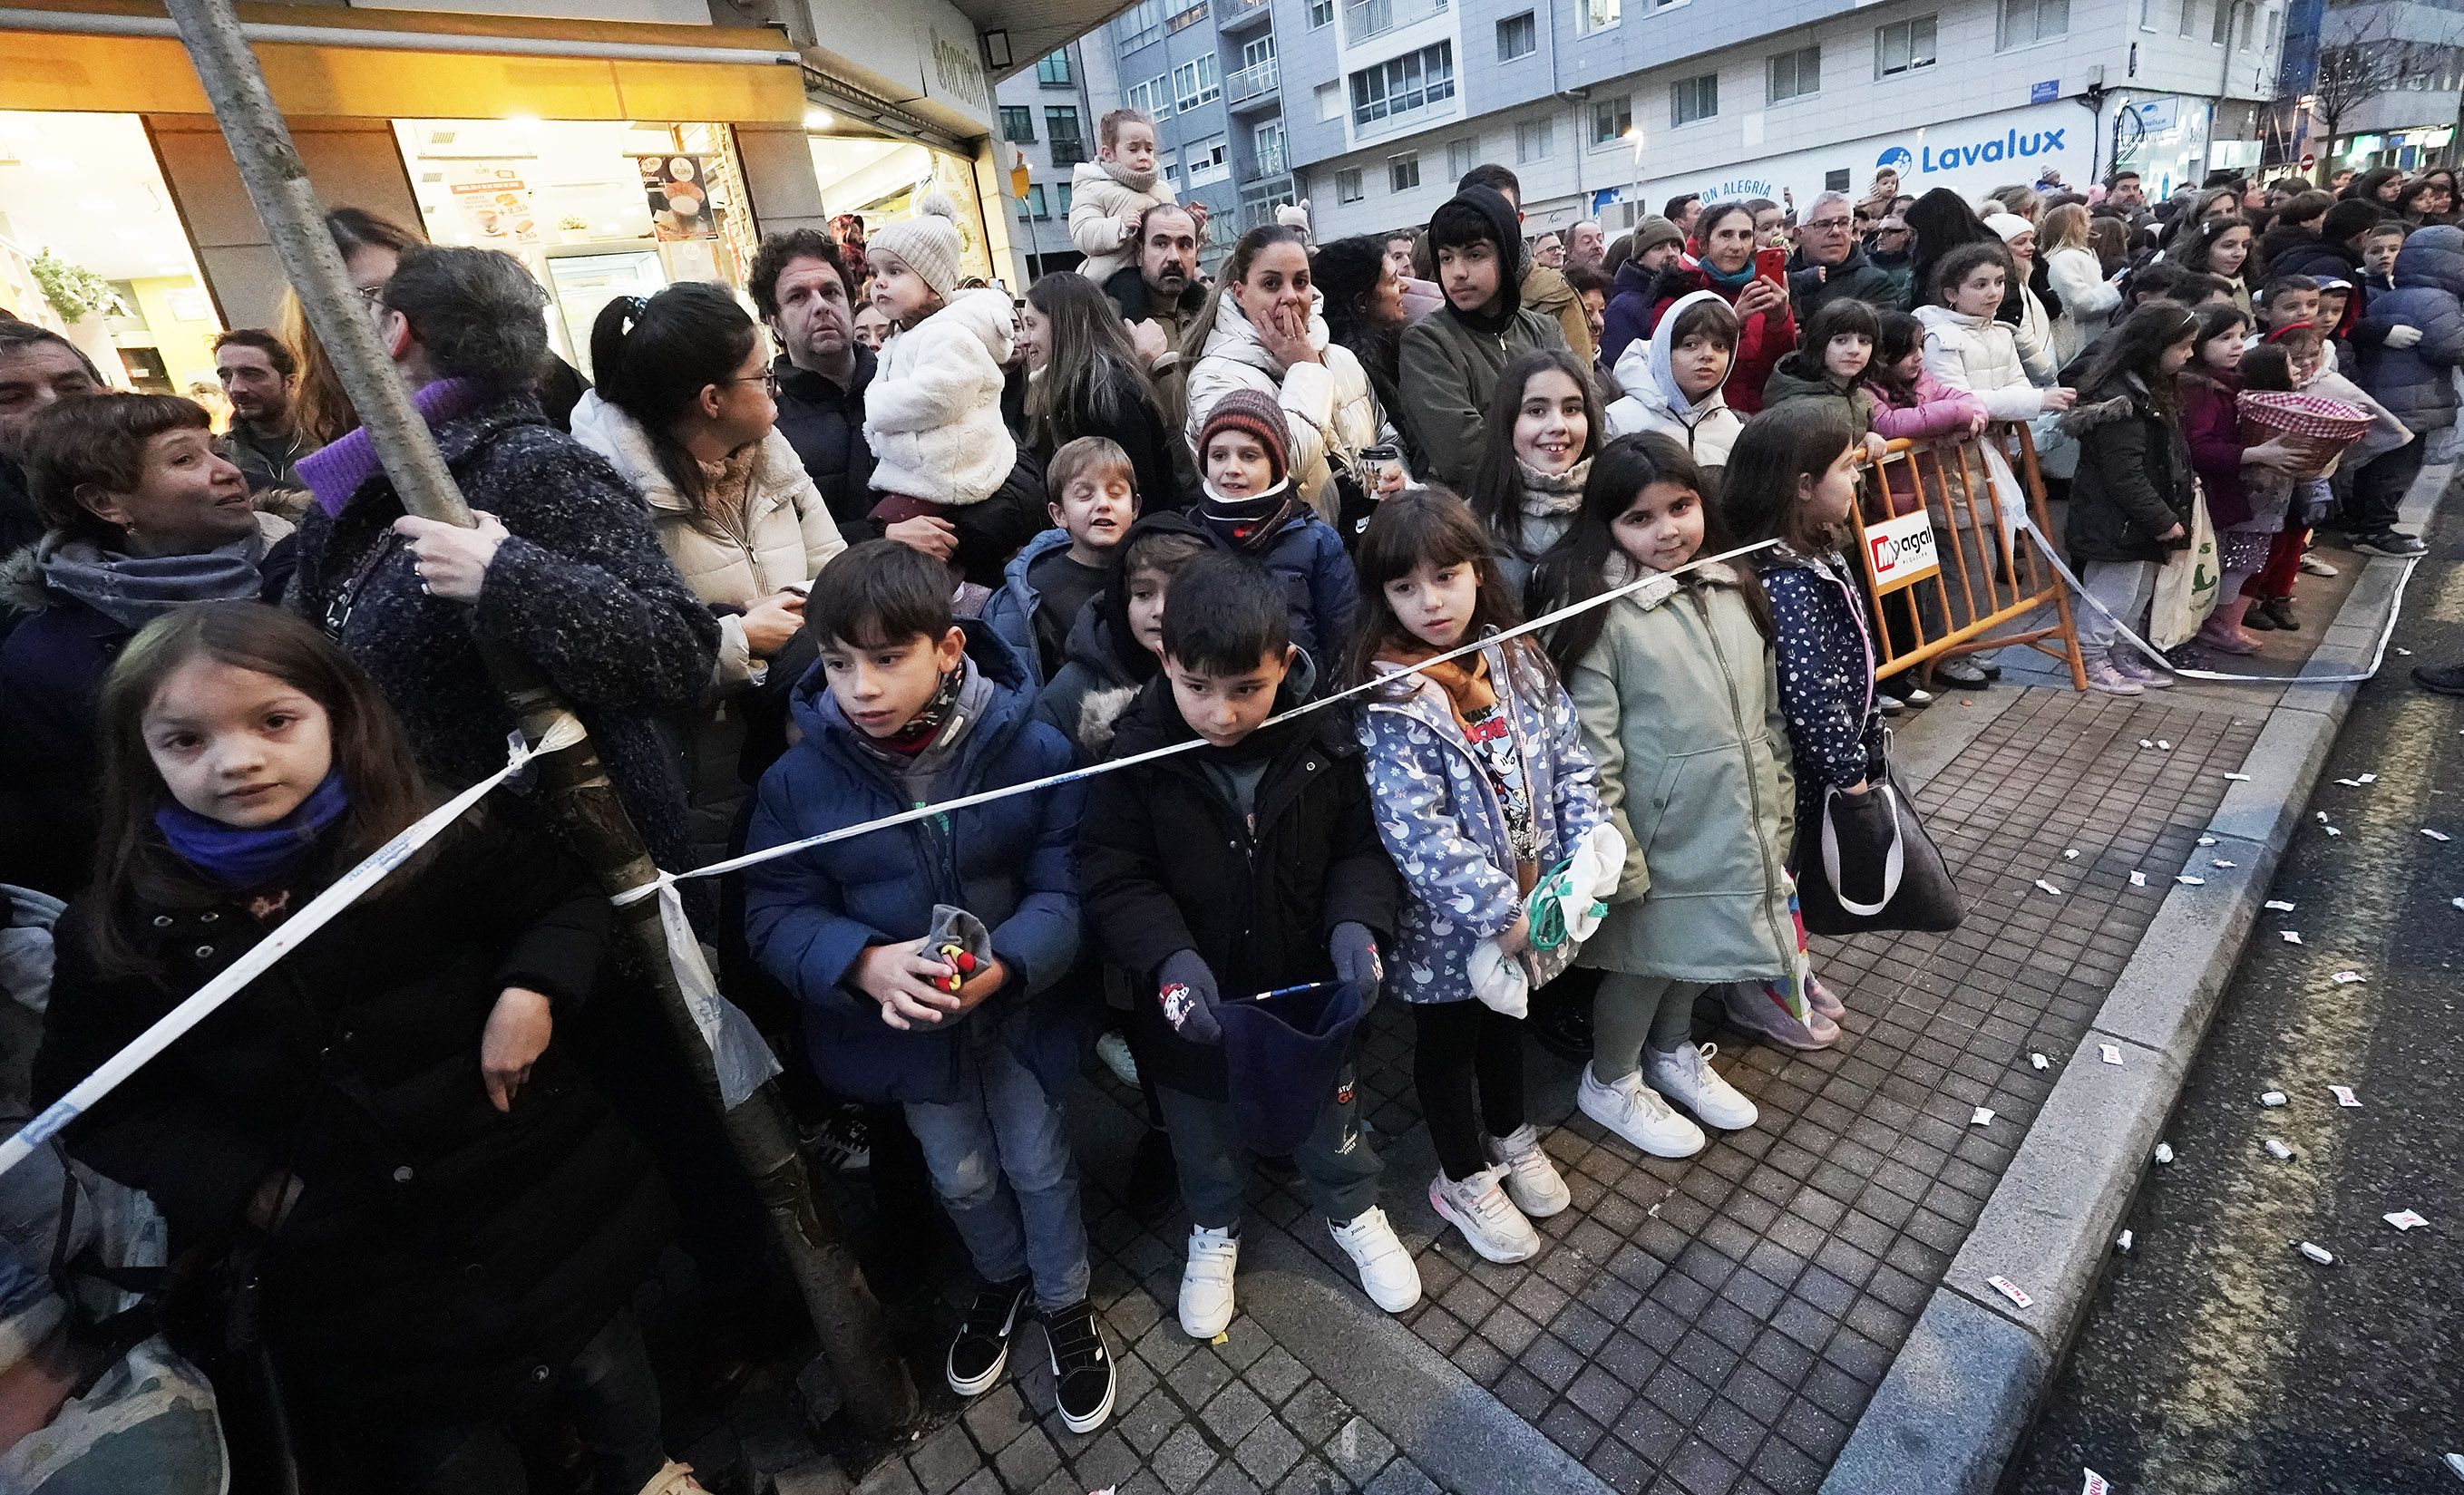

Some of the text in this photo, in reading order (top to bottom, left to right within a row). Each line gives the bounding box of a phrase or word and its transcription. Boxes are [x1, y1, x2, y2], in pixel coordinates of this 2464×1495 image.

[1923, 129, 2066, 173] Lavalux
[1701, 180, 1771, 206] ON ALEGRÍA
[1873, 526, 1932, 569] Myagal
